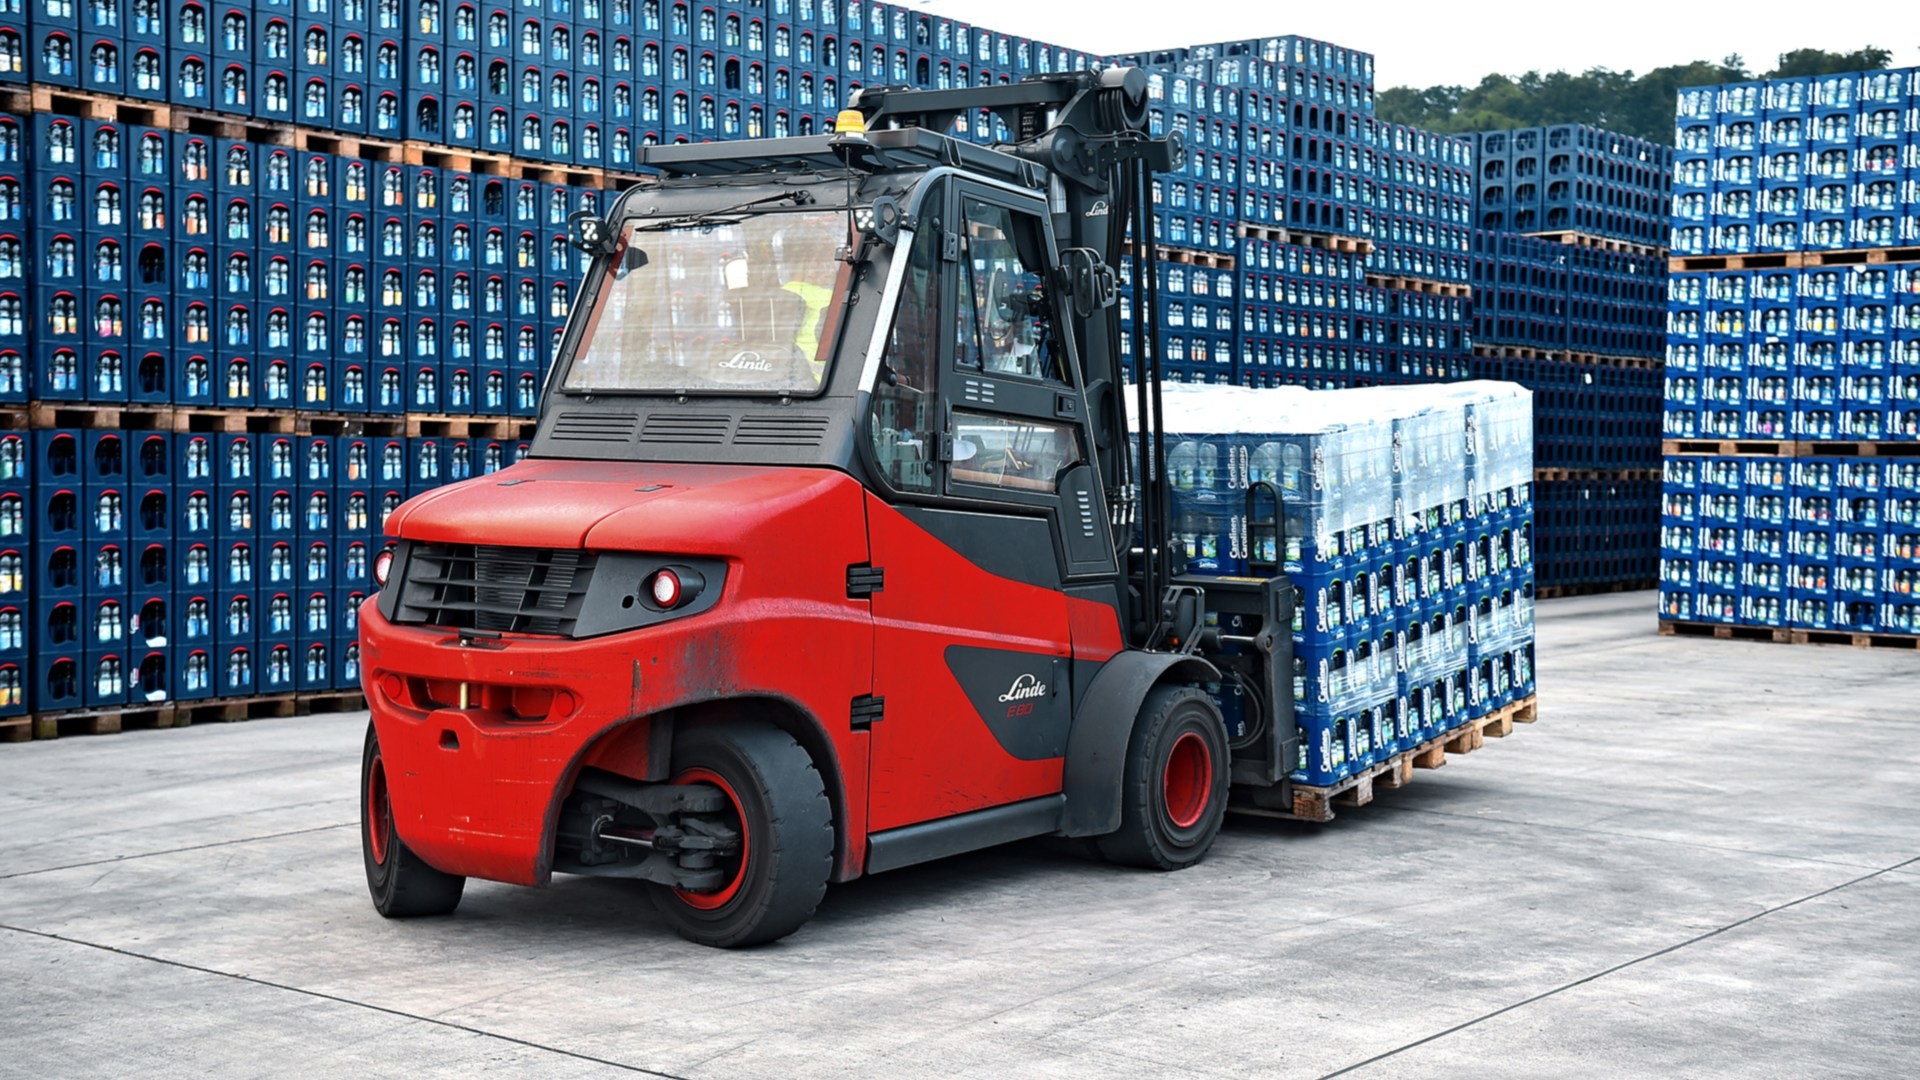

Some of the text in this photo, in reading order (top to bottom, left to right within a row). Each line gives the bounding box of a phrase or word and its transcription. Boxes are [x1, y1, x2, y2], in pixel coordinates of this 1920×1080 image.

[1085, 200, 1109, 217] Lind
[718, 350, 772, 371] Linde
[998, 673, 1046, 703] Linde
